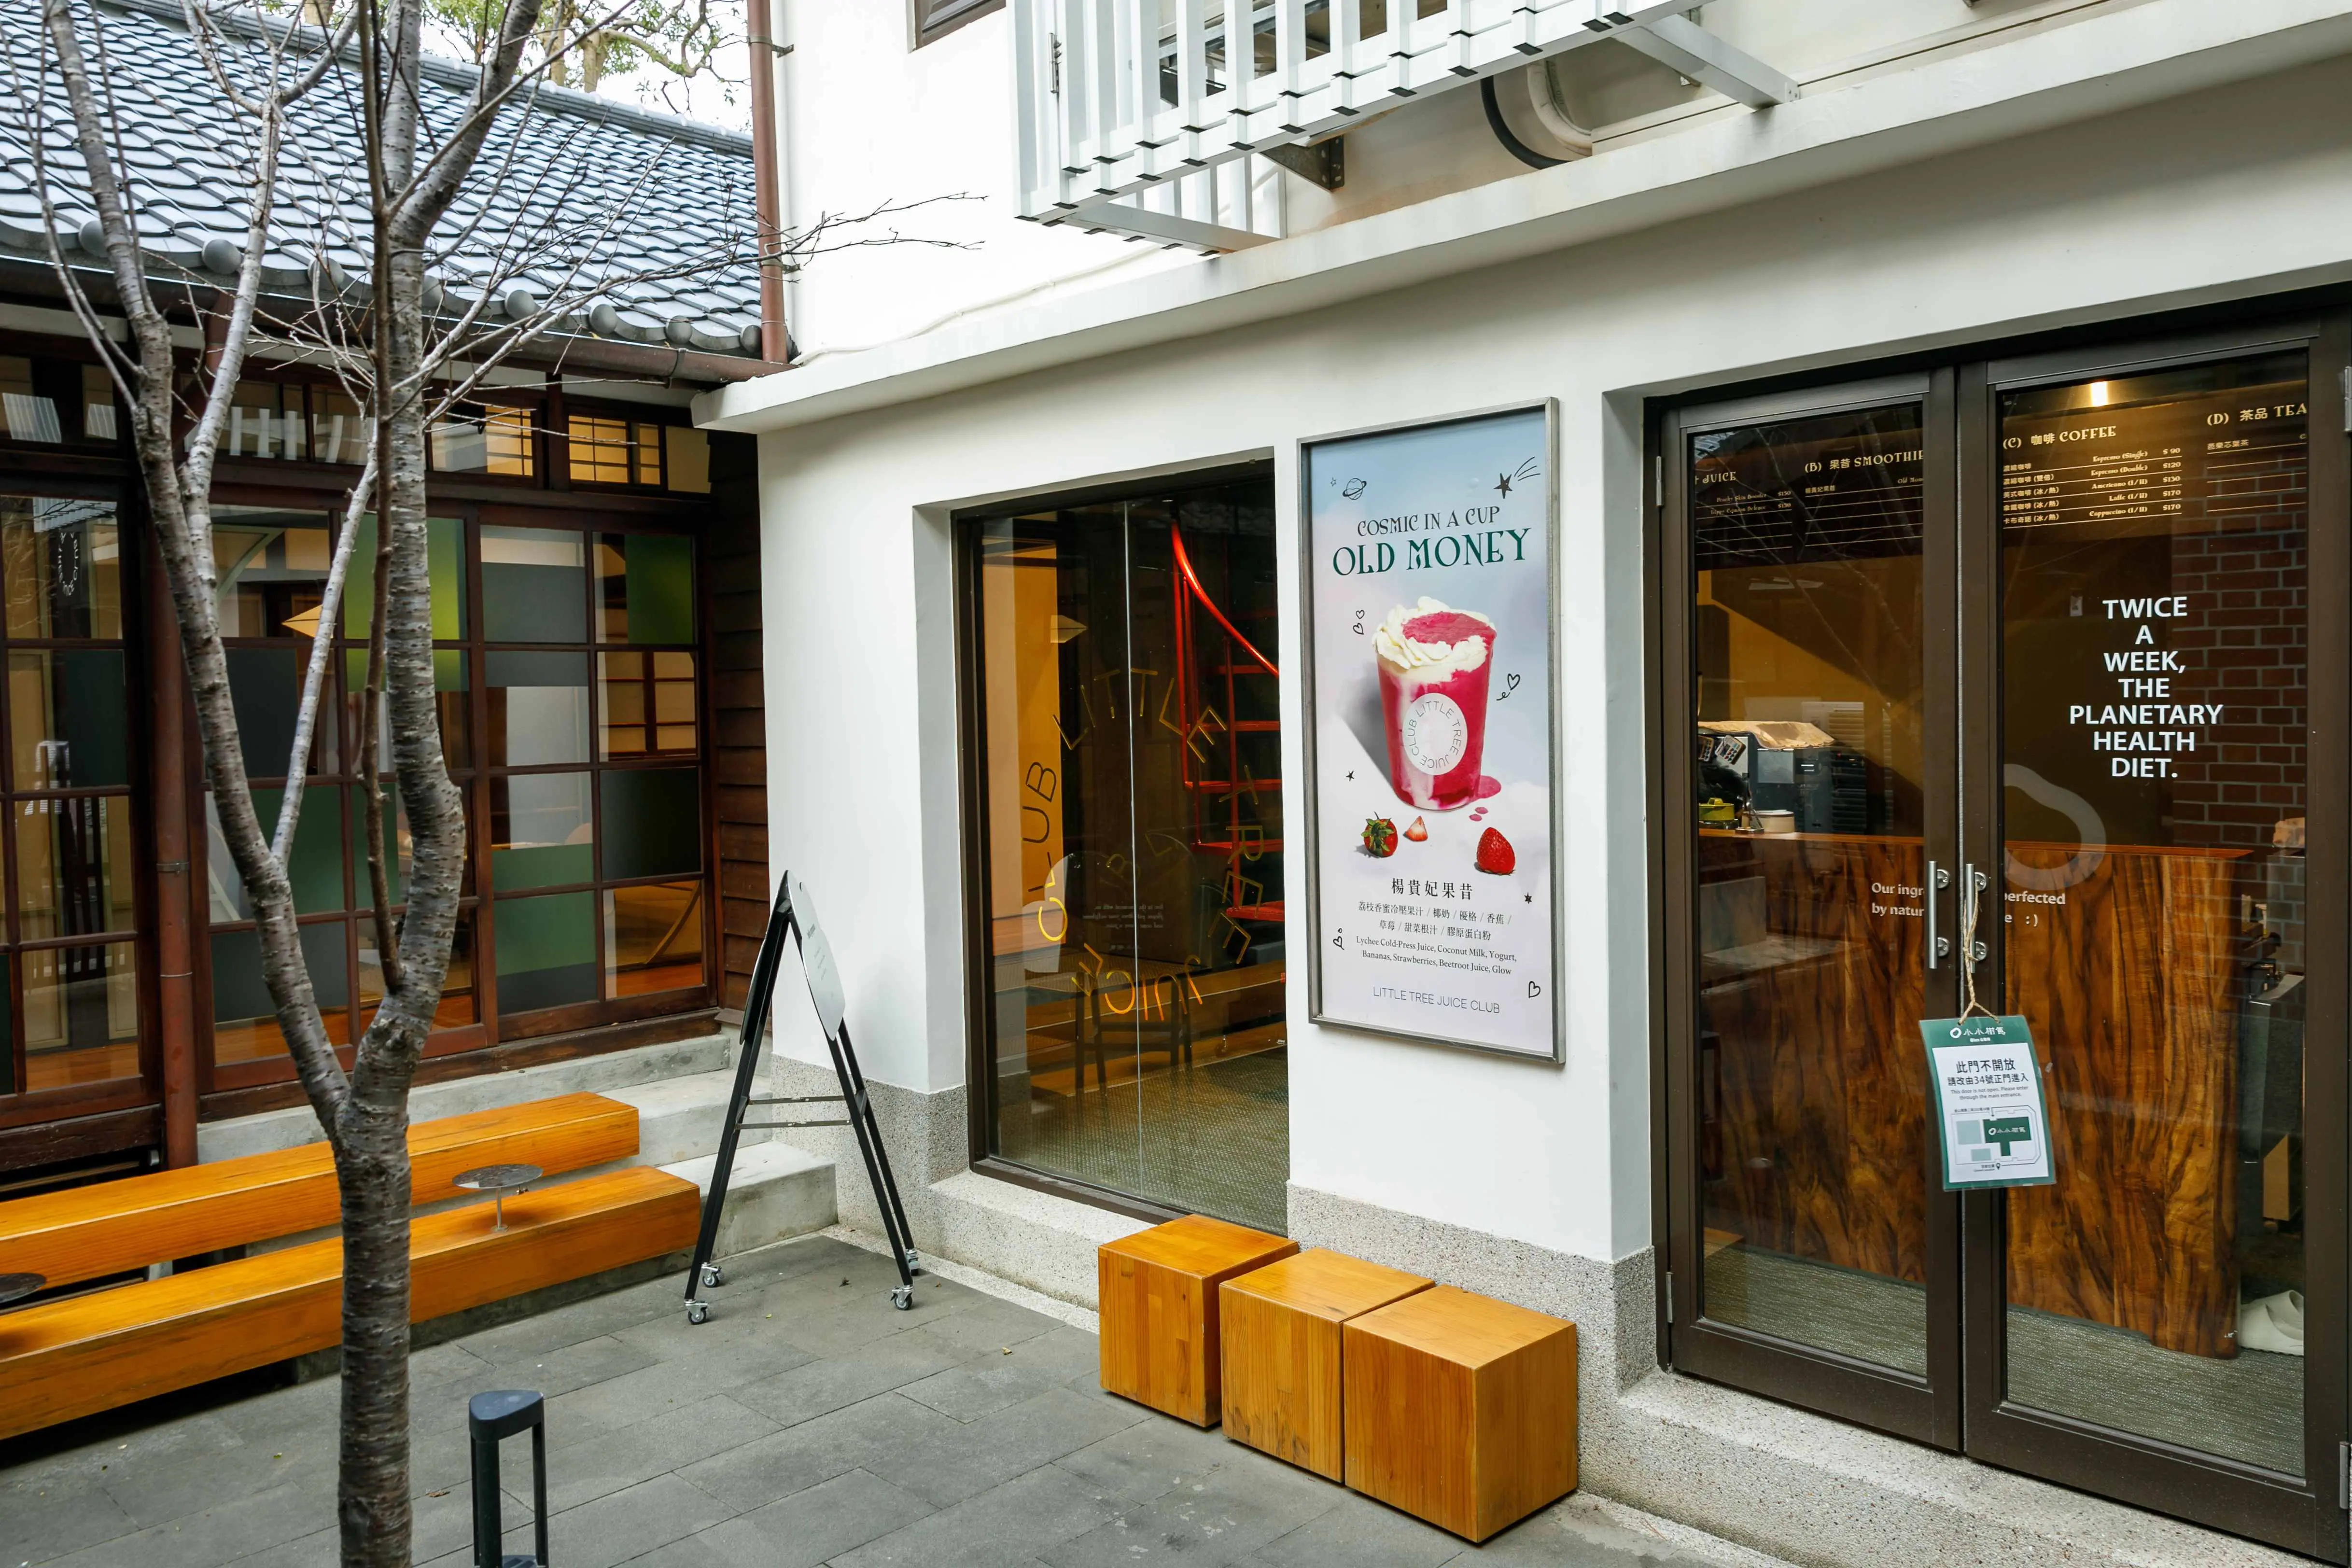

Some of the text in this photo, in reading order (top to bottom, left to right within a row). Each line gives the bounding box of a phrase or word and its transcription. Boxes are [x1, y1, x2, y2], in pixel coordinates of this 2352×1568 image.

[2207, 403, 2308, 426] (D) 茶品 TEA
[2003, 425, 2116, 449] (C) 咖啡 COFFEE
[1805, 462, 1822, 473] (B)
[1829, 458, 1850, 470] 果昔
[2093, 455, 2121, 463] Espresso
[1702, 471, 1736, 484] JUICE
[2091, 469, 2118, 477] Espresso
[1358, 506, 1500, 536] COSMIC IN A CUP
[2089, 509, 2126, 518] Cappuccino
[1333, 528, 1532, 576] OLD MONEY
[2102, 596, 2188, 619] TWICE
[2135, 625, 2154, 644] A
[2103, 651, 2186, 673] WEEK,
[2117, 677, 2170, 698] THE
[2070, 704, 2224, 725] PLANETARY
[1407, 700, 1462, 769] LITTLE TREE JUICE CLUB
[2093, 731, 2195, 751] HEALTH
[2112, 757, 2178, 778] DIET.
[1020, 761, 1067, 942] CLUB
[1391, 878, 1473, 900] 楊貴妃果昔
[1871, 882, 1895, 895] Our
[1898, 883, 1925, 898] ingr
[1358, 901, 1424, 917] 荔枝香蜜冷壓果汁
[1433, 908, 1450, 919] 椰奶
[1459, 910, 1477, 922] 優格
[1486, 913, 1504, 924] 香蕉
[1872, 903, 1887, 917] by
[1890, 906, 1925, 917] natur
[1379, 919, 1396, 931] 草莓
[1404, 922, 1438, 935] 甜菜根汁
[1447, 926, 1491, 941] 膠原蛋白粉
[1356, 936, 1517, 962] Lychee Cold-Press Juice, Coconut Milk, Yogurt,
[1362, 950, 1512, 975] Bananas, Strawberries, Beetroot Juice, Glow
[1072, 943, 1203, 1021] JUICE
[1373, 986, 1500, 1014] LITTLE TREE JUICE CLUB
[1956, 1058, 2016, 1074] 此門不開放
[1947, 1073, 2029, 1086] 請改由34號正門進入
